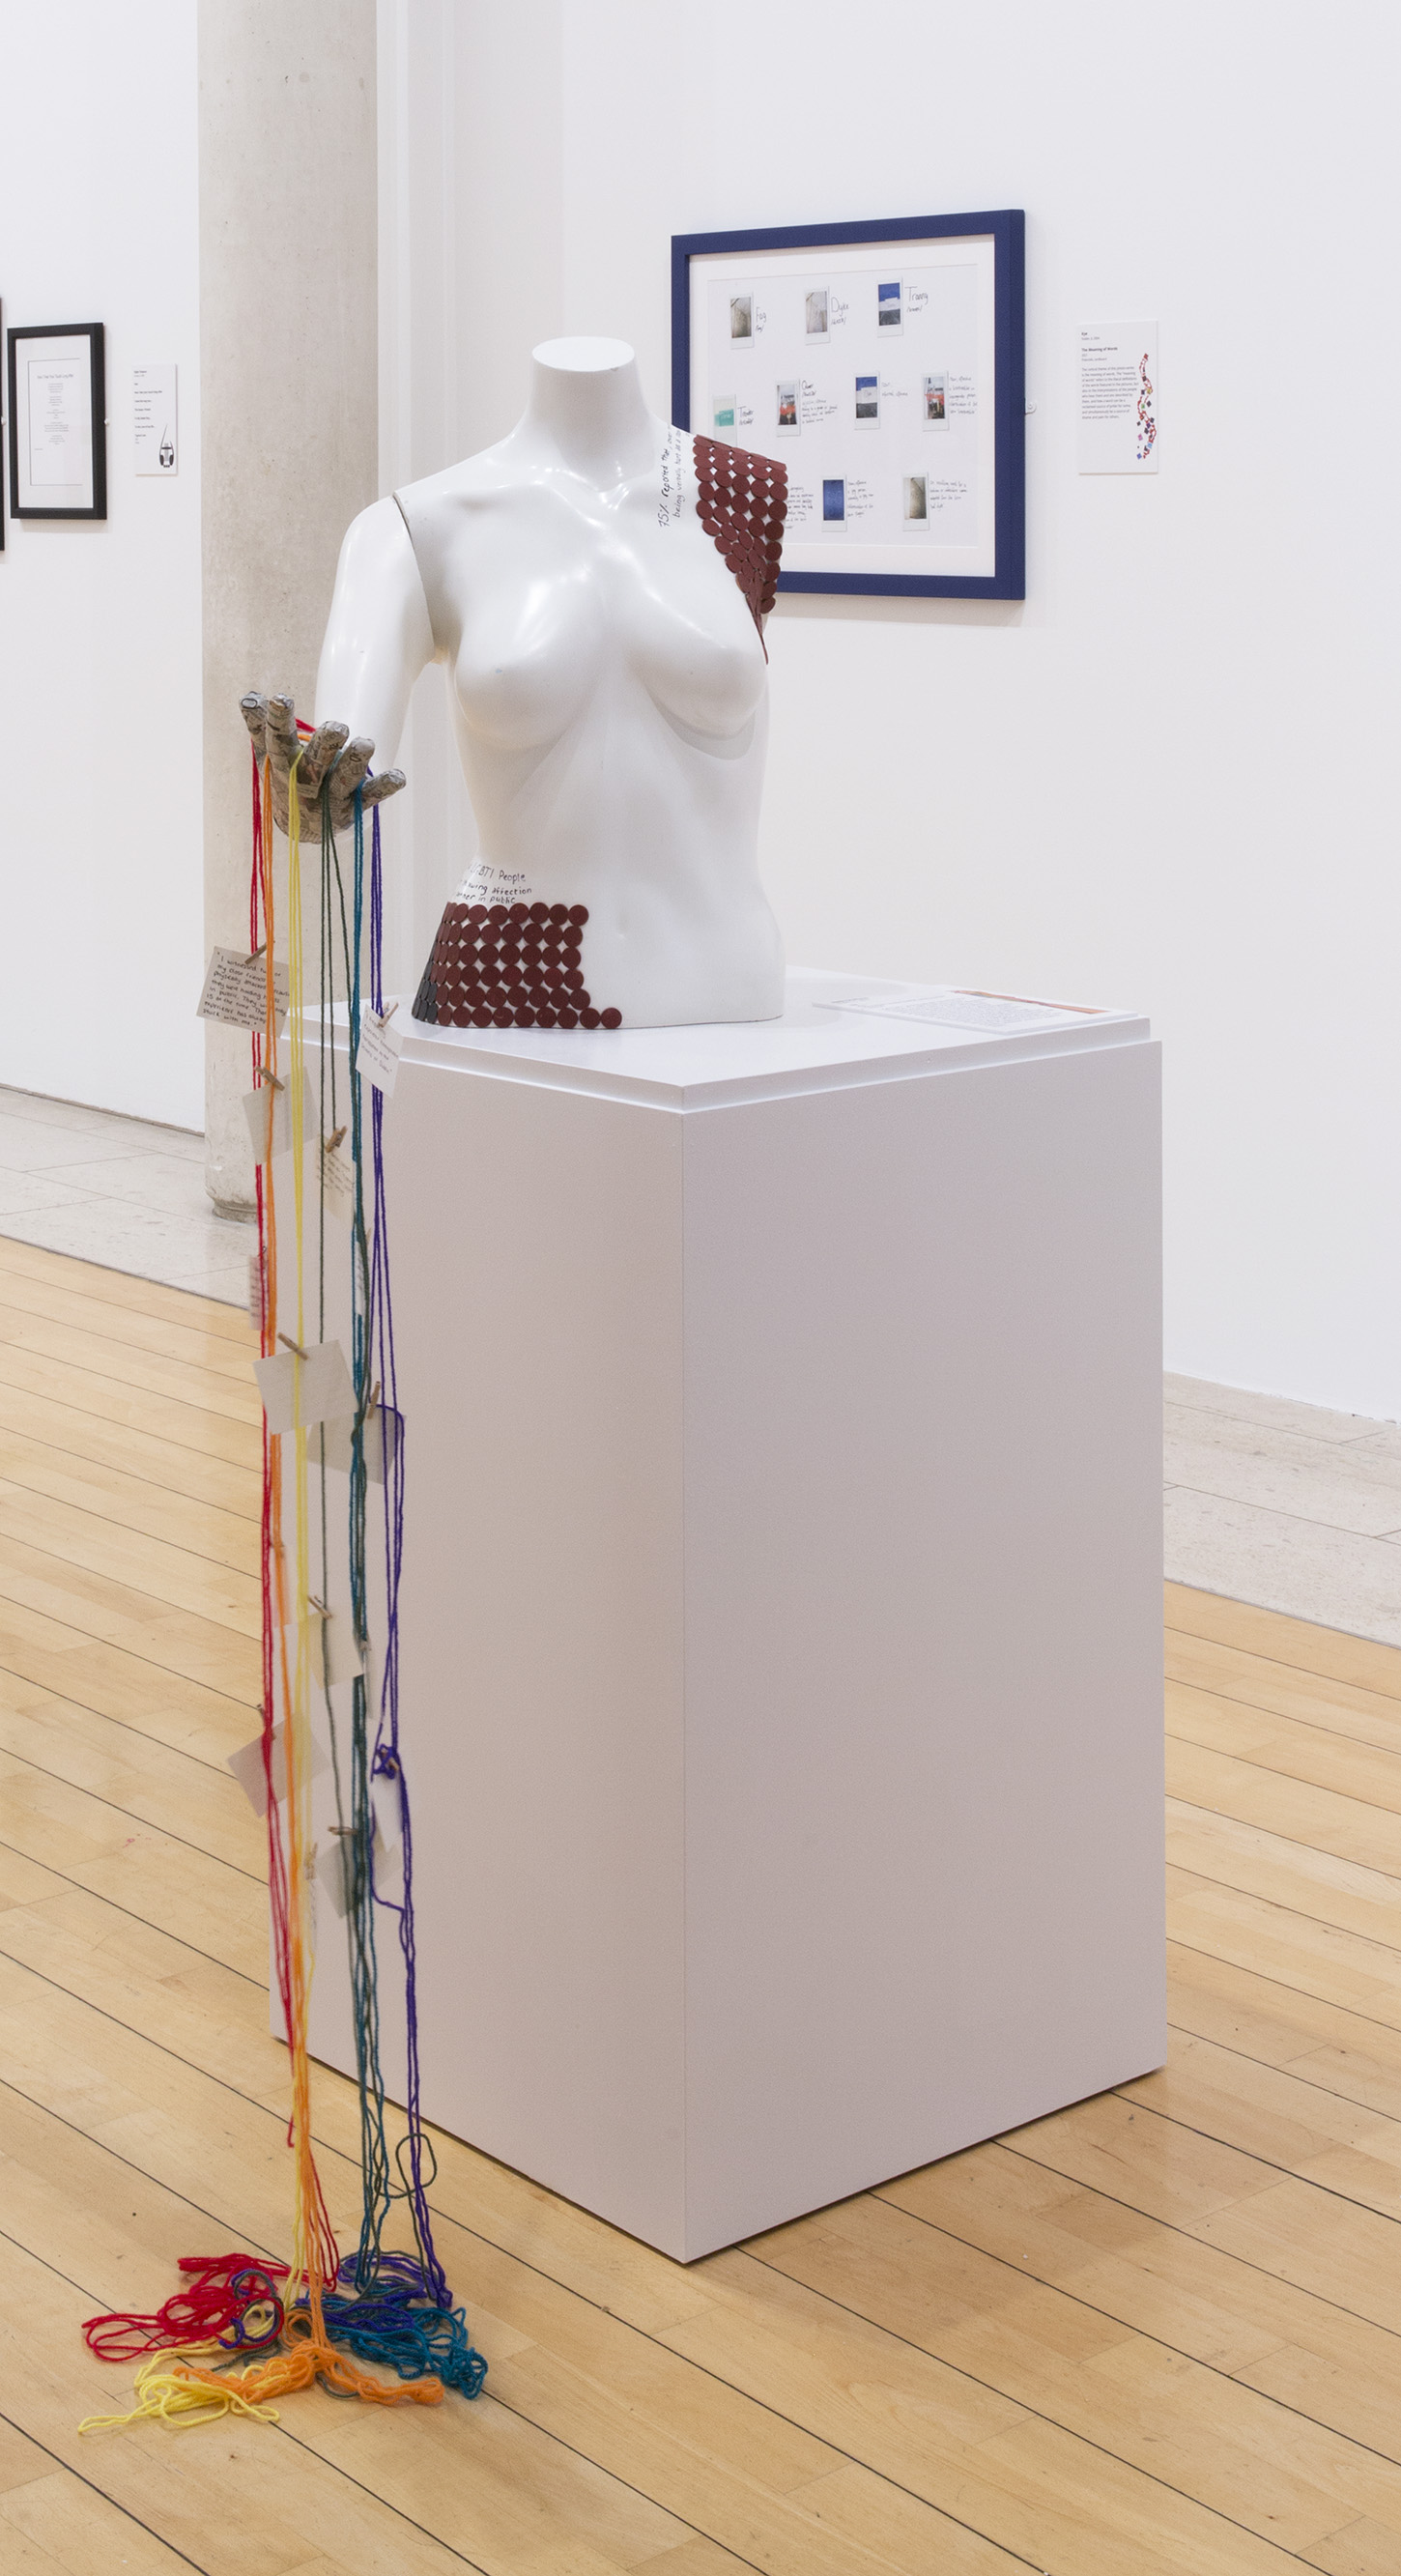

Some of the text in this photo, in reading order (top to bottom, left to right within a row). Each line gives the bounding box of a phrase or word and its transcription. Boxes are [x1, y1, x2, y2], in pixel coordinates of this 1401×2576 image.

[831, 296, 849, 317] Dyke
[661, 465, 674, 497] reported
[672, 495, 685, 518] being
[658, 503, 670, 527] 75%
[498, 870, 526, 884] People
[492, 886, 532, 895] affection
[218, 964, 226, 973] my
[212, 980, 224, 989] they
[214, 971, 241, 985] physically
[243, 996, 256, 1007] They
